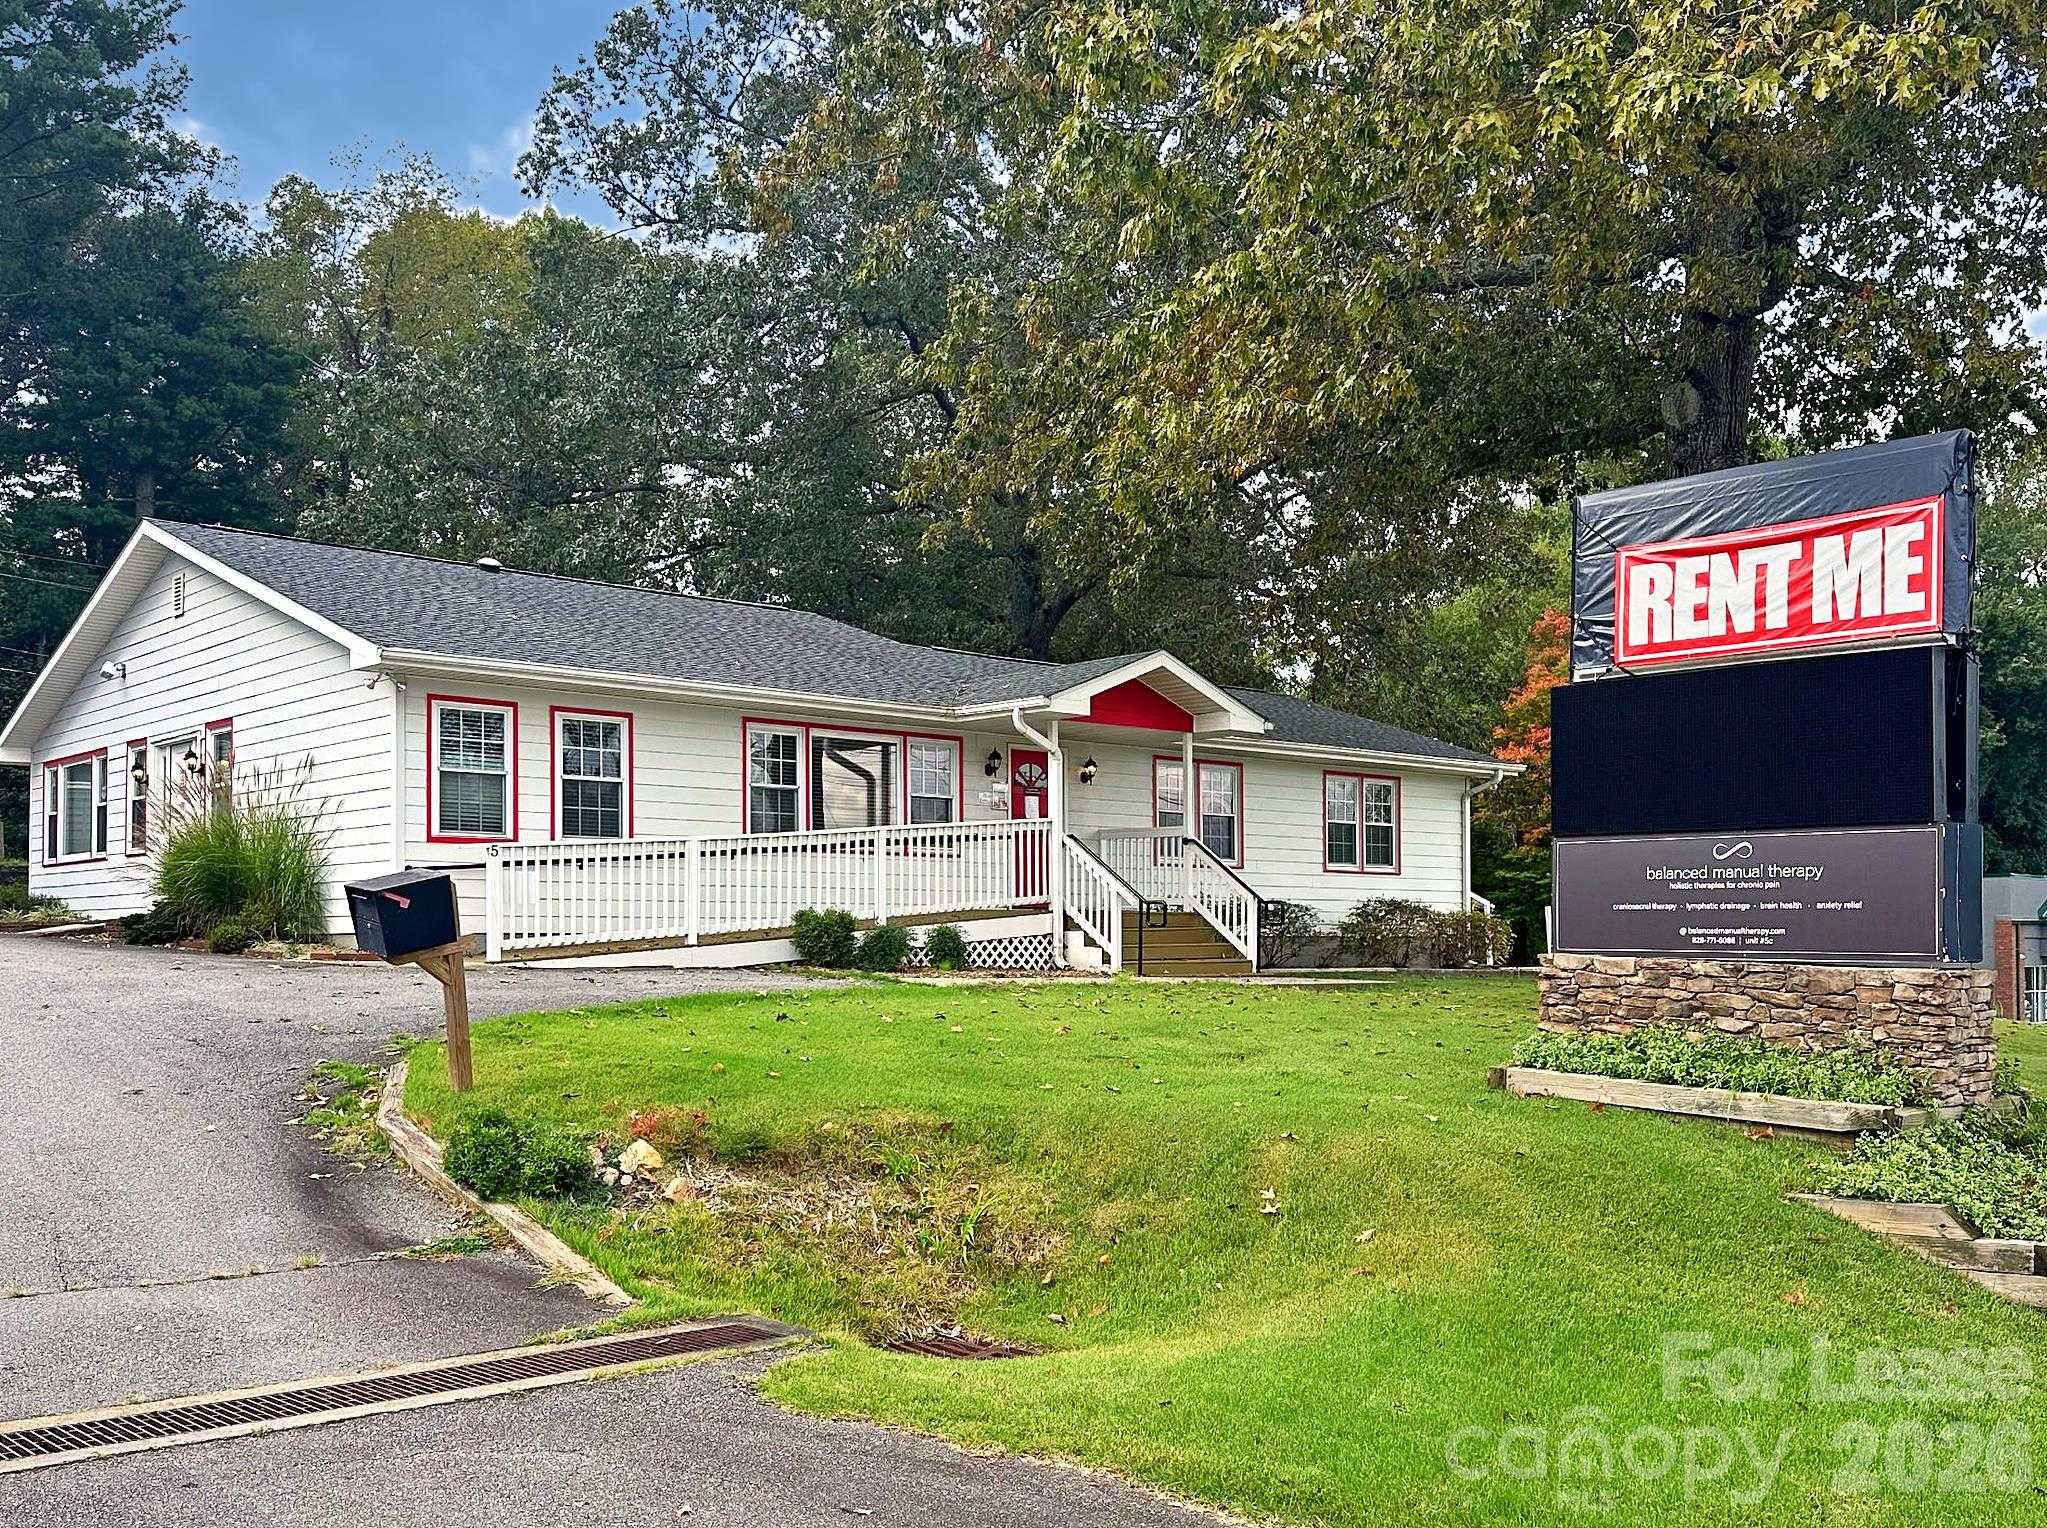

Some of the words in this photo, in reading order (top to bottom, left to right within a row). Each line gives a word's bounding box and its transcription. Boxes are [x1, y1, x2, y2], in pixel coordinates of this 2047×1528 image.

[1629, 541, 1802, 646] RENT
[1811, 521, 1925, 625] ME
[1646, 864, 1708, 880] balanced
[1712, 863, 1763, 879] manual
[1767, 863, 1824, 881] therapy
[1669, 882, 1693, 890] holistic
[1694, 881, 1725, 890] therapies
[1726, 881, 1736, 889] for
[1737, 881, 1763, 889] chronic
[1765, 881, 1780, 890] pain
[1652, 902, 1677, 912] therapy
[1686, 902, 1719, 912] lymphatic
[1720, 901, 1750, 911] drainage
[1760, 901, 1778, 910] brain
[1780, 901, 1802, 910] health
[1816, 901, 1842, 911] anxiety
[1843, 900, 1863, 910] relief
[1745, 936, 1758, 944] unit
